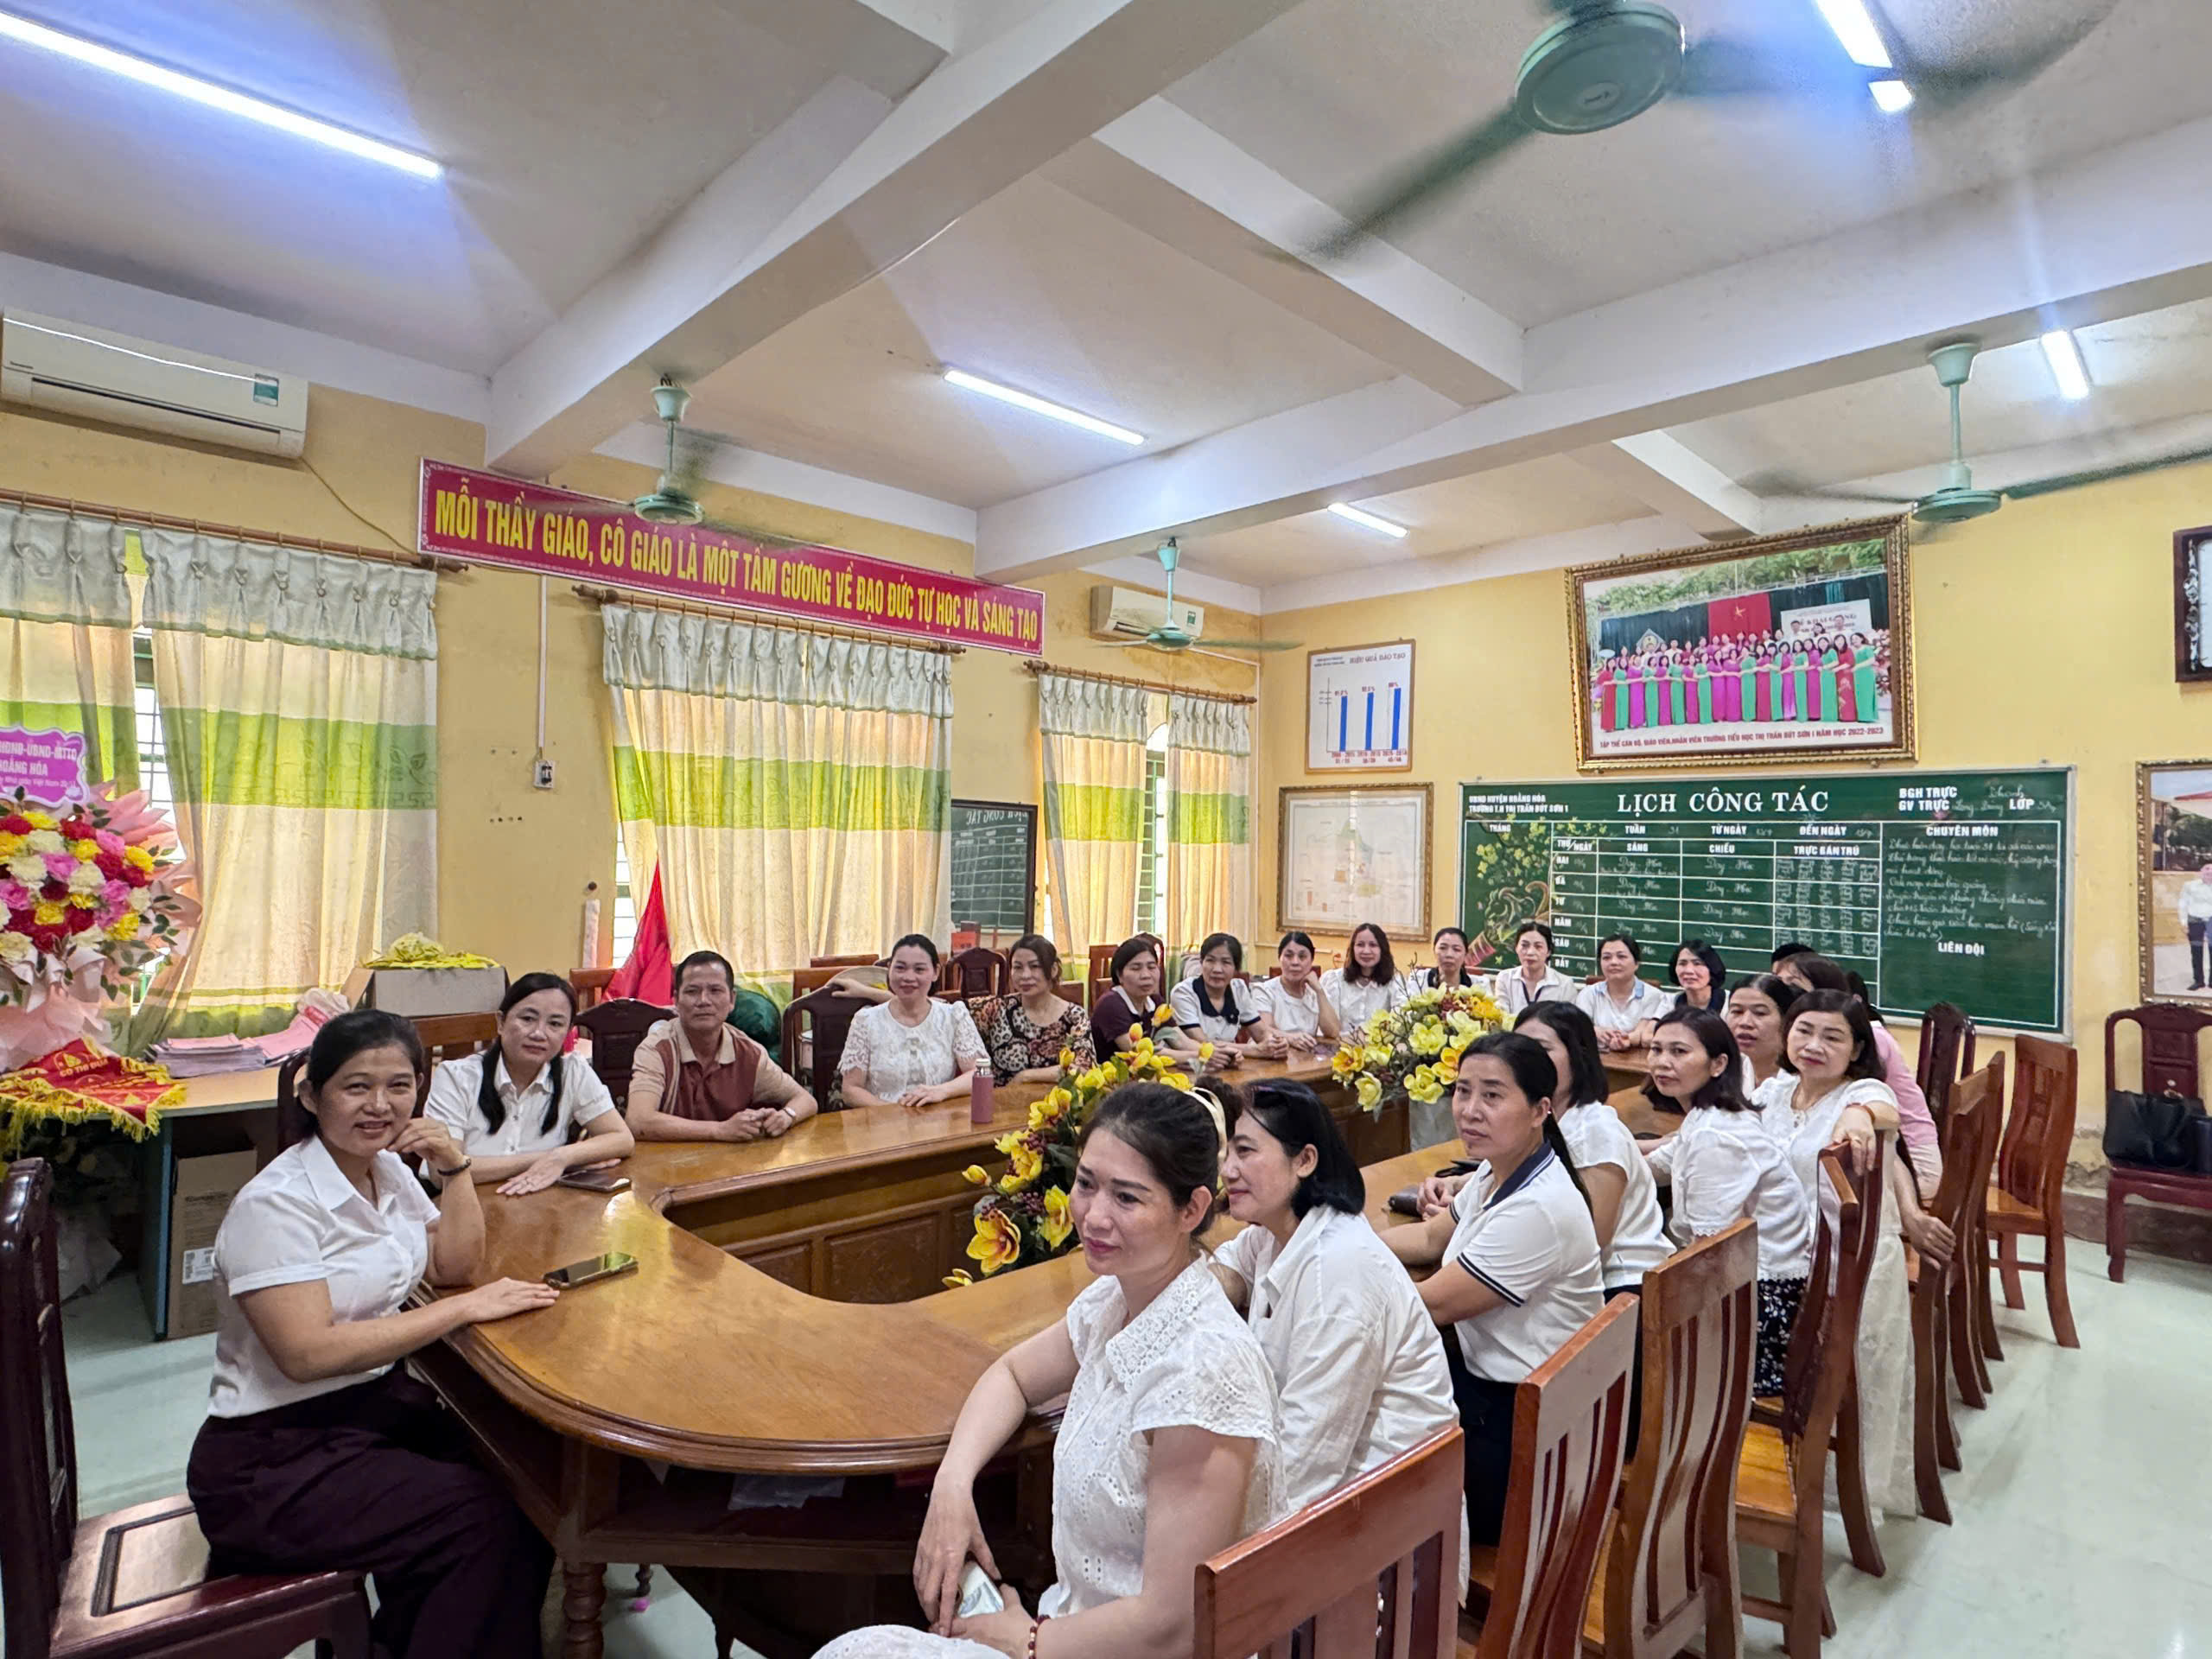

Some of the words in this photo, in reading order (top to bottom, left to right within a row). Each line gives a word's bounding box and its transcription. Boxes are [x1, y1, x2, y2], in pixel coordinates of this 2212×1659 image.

[435, 477, 479, 540] MỖI
[485, 491, 537, 551] THẦY
[543, 508, 594, 567] GIÁO,
[601, 518, 626, 567] CÔ
[631, 526, 672, 577] GIÁO
[677, 532, 697, 582] LÀ
[703, 540, 739, 594] MỘT
[743, 543, 777, 595] TẤM
[780, 560, 832, 606] GƯƠNG
[836, 562, 854, 609] VỀ
[856, 575, 884, 621] ĐẠO
[887, 574, 913, 620] ĐỨC
[918, 587, 935, 631] TỰ
[936, 592, 961, 634] HỌC
[964, 591, 980, 631] VÀ
[982, 595, 1014, 637] SÁNG
[1017, 607, 1038, 647] TẠO
[1899, 788, 1923, 798] BGH
[1926, 785, 1957, 799] TRỰC
[1618, 793, 1677, 817] LỊCH
[1689, 786, 1763, 812] CÔNG
[1772, 785, 1828, 811] TÁC
[1898, 800, 1914, 811] GV
[1919, 798, 1950, 812] TRỰC
[2009, 798, 2035, 810] LỚP
[1625, 823, 1646, 834] TUẦN
[1711, 823, 1723, 835] TỪ
[1724, 823, 1747, 835] NGÀY
[1799, 823, 1819, 836] ĐẾN
[1821, 824, 1847, 836] NGÀY
[1926, 824, 1969, 836] CHUYÊN
[1972, 825, 1999, 836] MÔN
[1627, 841, 1649, 852] SÁNG
[1709, 842, 1735, 854] CHIỀU
[1794, 845, 1818, 855] TRỰC
[1820, 845, 1840, 855] BÁN
[1554, 917, 1572, 927] NĂM
[1555, 937, 1570, 947] SÁU
[1937, 941, 1963, 953] LIÊN
[1965, 942, 1985, 957] ĐỘI
[1555, 957, 1569, 968] BẢY
